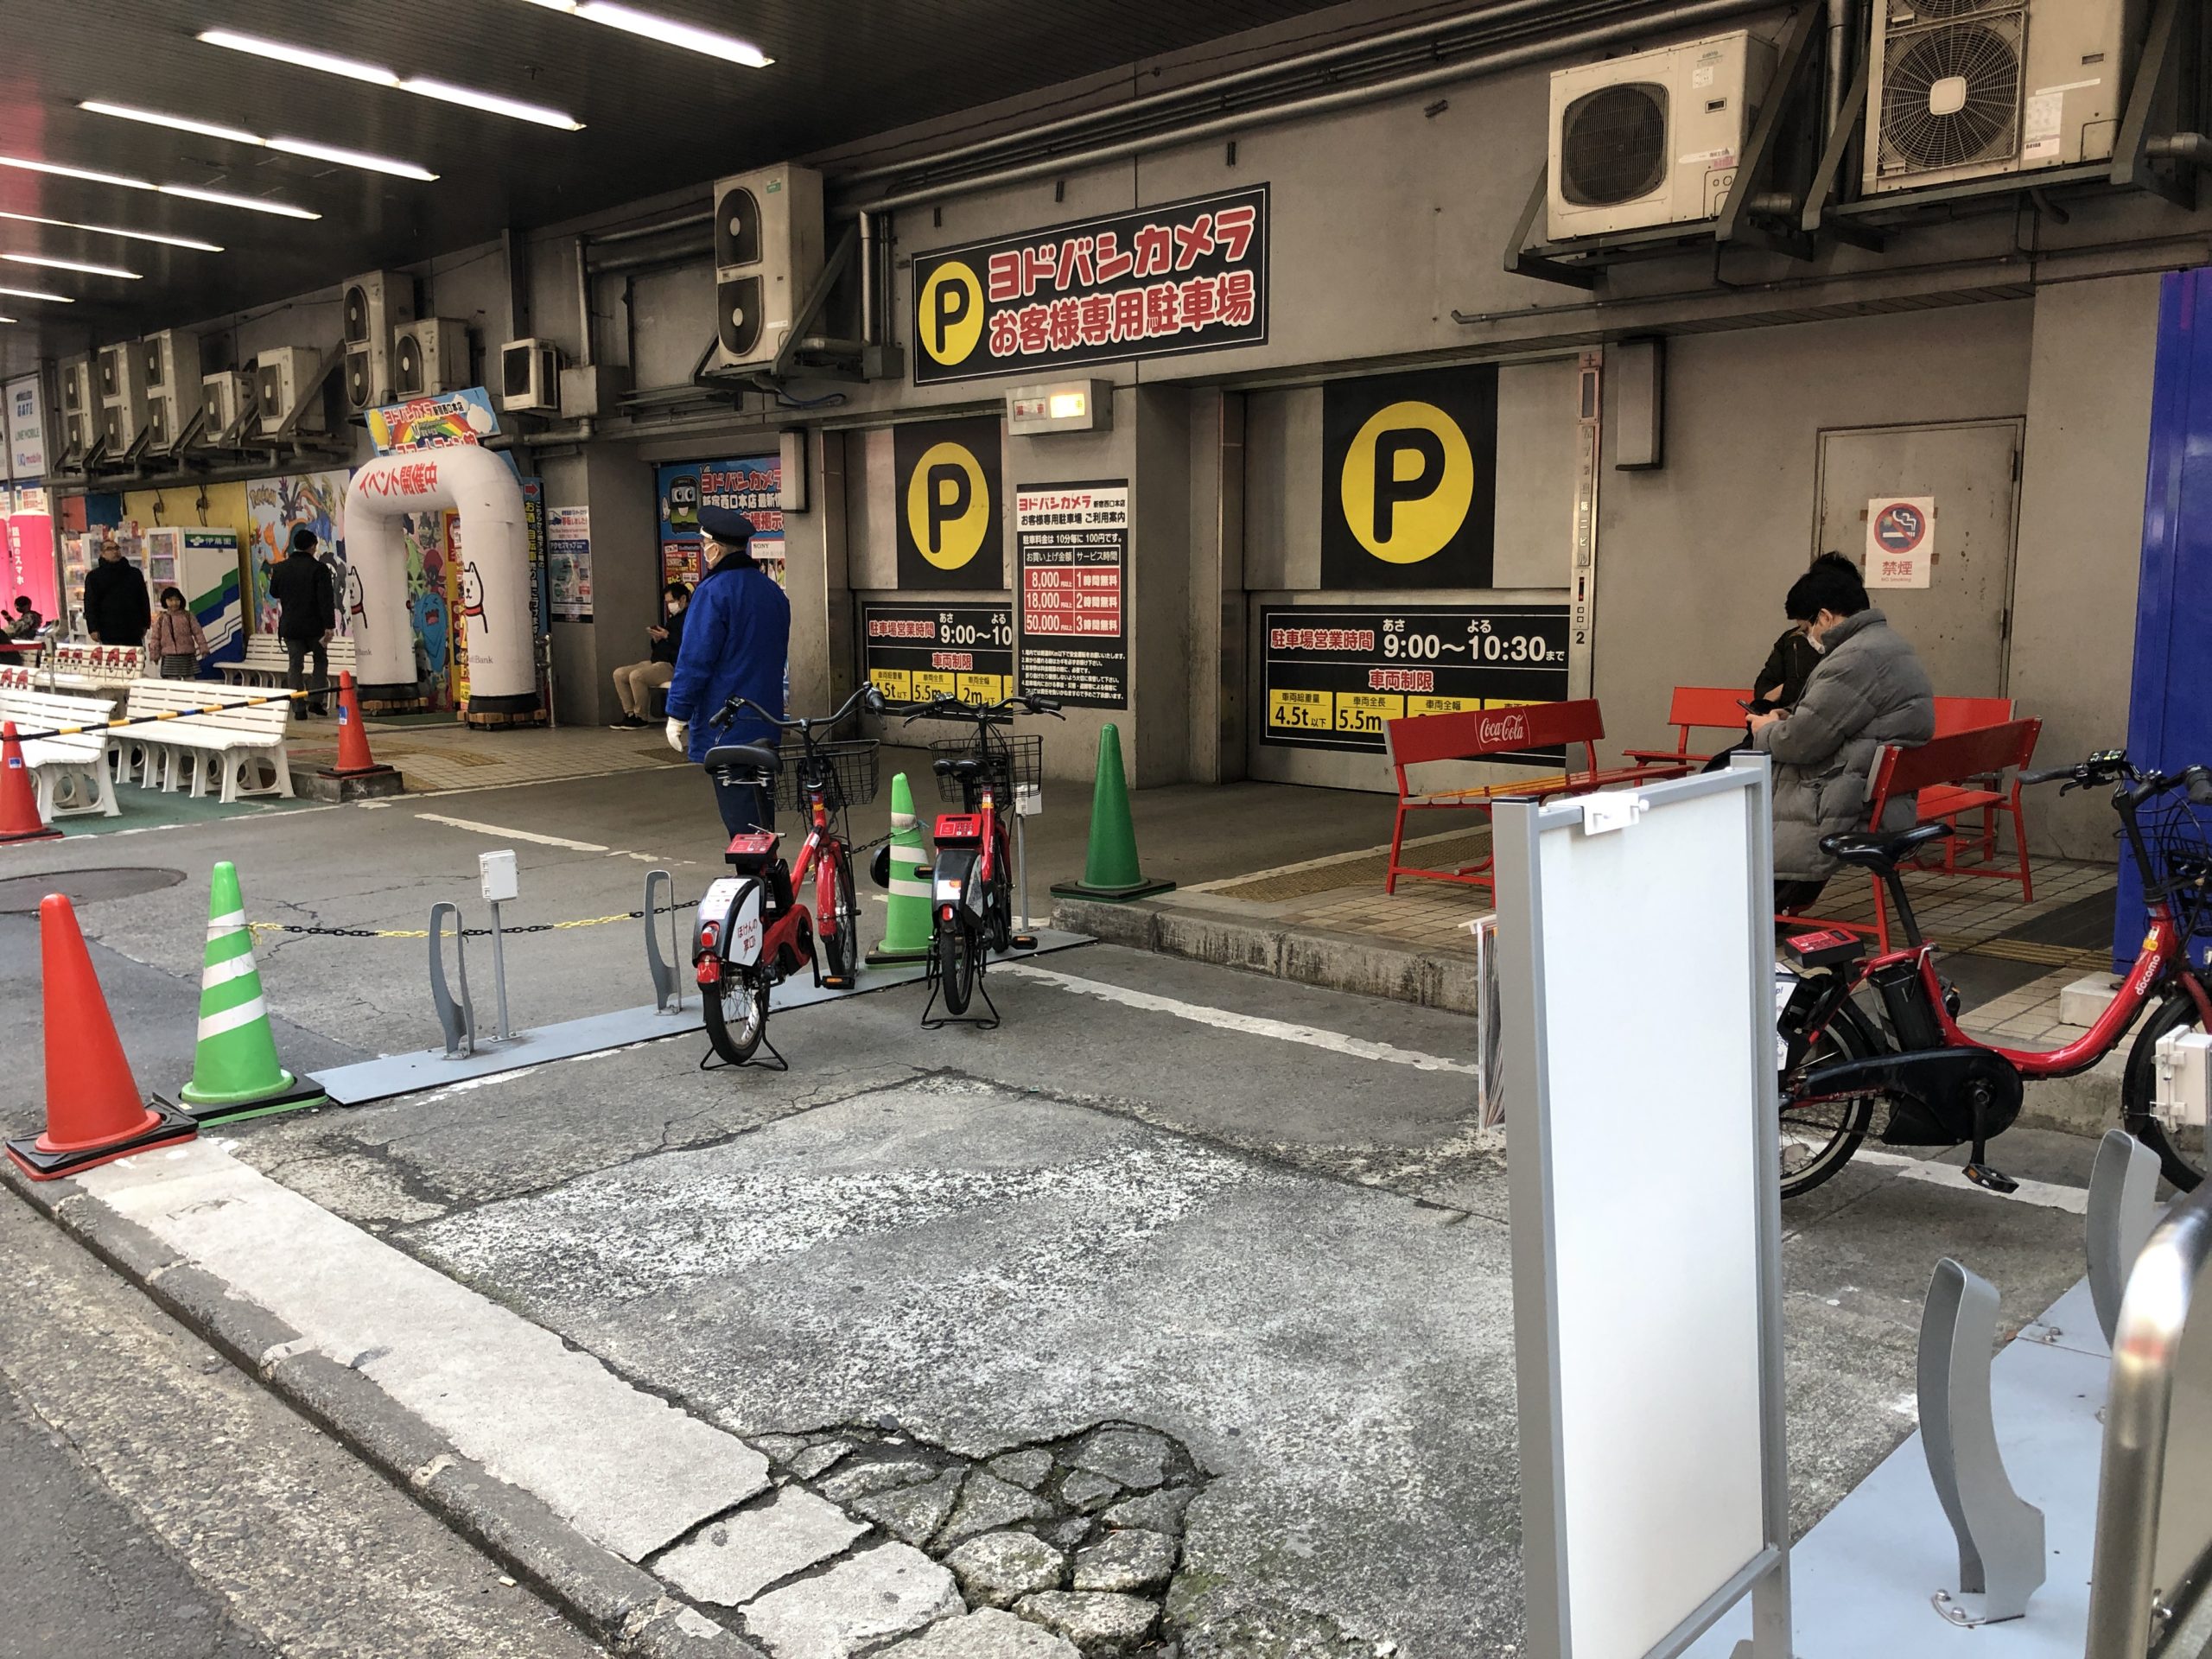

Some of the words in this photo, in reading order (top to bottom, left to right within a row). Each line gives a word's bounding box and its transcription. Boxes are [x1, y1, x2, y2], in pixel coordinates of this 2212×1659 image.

[988, 205, 1255, 302] ヨドバシカメラ
[934, 277, 970, 353] P
[988, 269, 1255, 357] お客様専用駐車場
[383, 402, 433, 426] ヨドバシカメラ
[359, 461, 438, 499] イベント開催中
[1373, 428, 1446, 544] P
[927, 463, 972, 555] P
[1019, 495, 1091, 511] ヨドバシカメラ
[1093, 499, 1125, 508] 新宿西口本店
[1021, 513, 1082, 525] お客様専用駐車場
[1085, 512, 1125, 524] ご利用案内
[1022, 535, 1054, 545] 駐車料金は
[1027, 551, 1072, 562] お買い上げ金額
[1077, 550, 1117, 562] サービス時間
[1882, 561, 1912, 576] 禁煙
[939, 613, 954, 624] あさ
[991, 613, 1006, 625] よる
[1382, 619, 1405, 632] あさ
[1467, 620, 1491, 633] よる
[868, 620, 935, 639] 駐車場営業時間
[1575, 632, 1585, 645] 2
[1270, 628, 1375, 651] 駐車場営業時間
[931, 652, 973, 671] 車両制限
[1368, 669, 1433, 692] 車両制限
[1281, 692, 1319, 704] 車両総重量
[1353, 696, 1386, 708] 車両全長
[1426, 700, 1460, 710] 車両全幅
[1311, 717, 1326, 728] 以下
[1339, 709, 1382, 731] 5.5m
[1480, 715, 1523, 743] Coca-Cola
[2135, 955, 2160, 995] docomo
